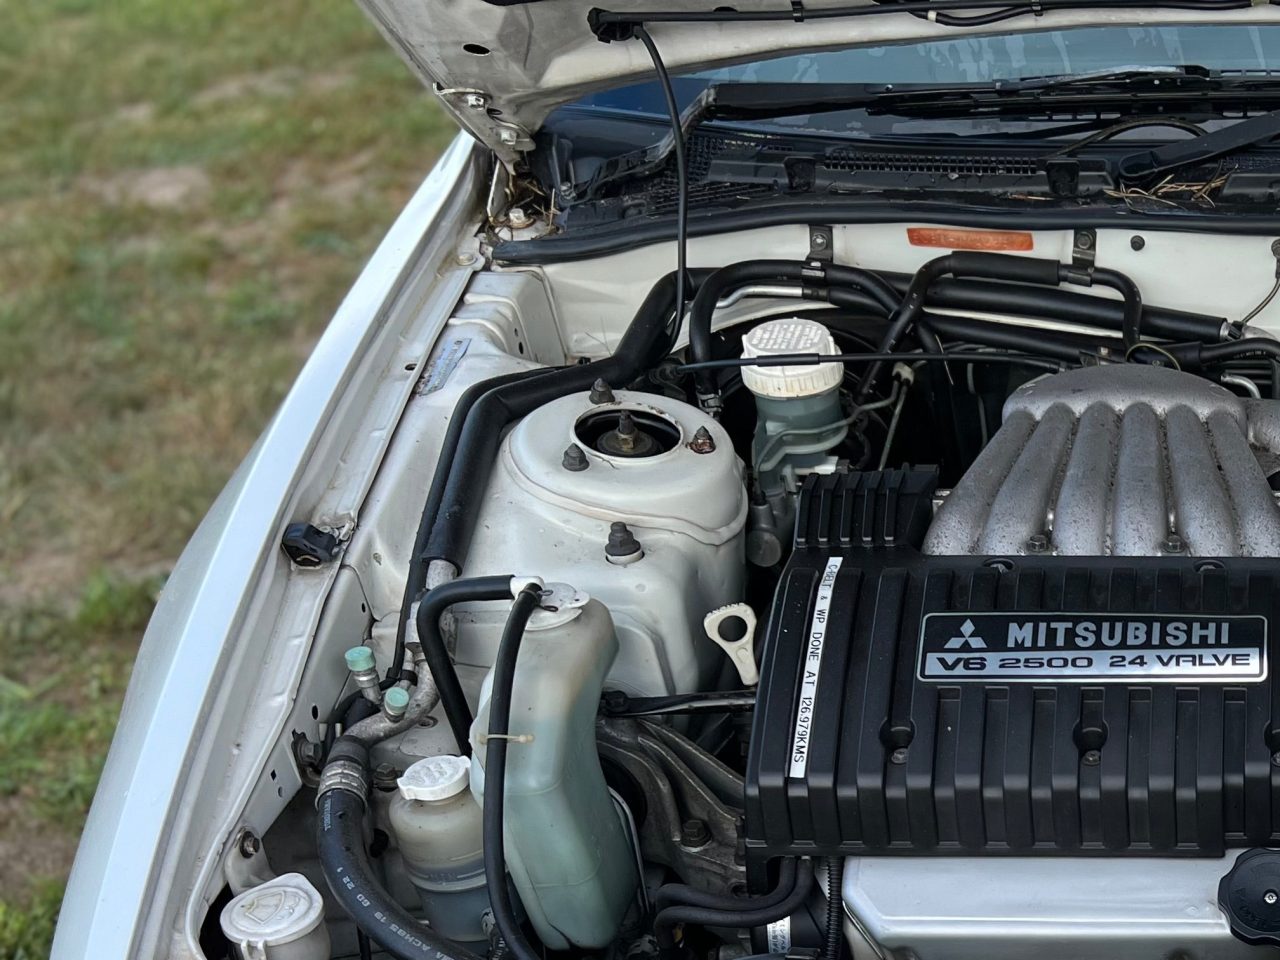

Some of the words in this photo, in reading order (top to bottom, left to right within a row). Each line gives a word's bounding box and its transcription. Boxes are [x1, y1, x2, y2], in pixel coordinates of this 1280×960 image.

[821, 564, 838, 588] C-BELT
[816, 608, 827, 624] WP
[1006, 621, 1230, 648] MITSUBISHI
[808, 631, 822, 661] DONE
[936, 656, 987, 671] V6
[998, 656, 1094, 669] 2500
[1108, 655, 1148, 668] 24
[1155, 653, 1251, 667] VALVE
[804, 670, 816, 686] AT
[794, 697, 812, 763] 126.979KMS
[342, 875, 355, 890] 22
